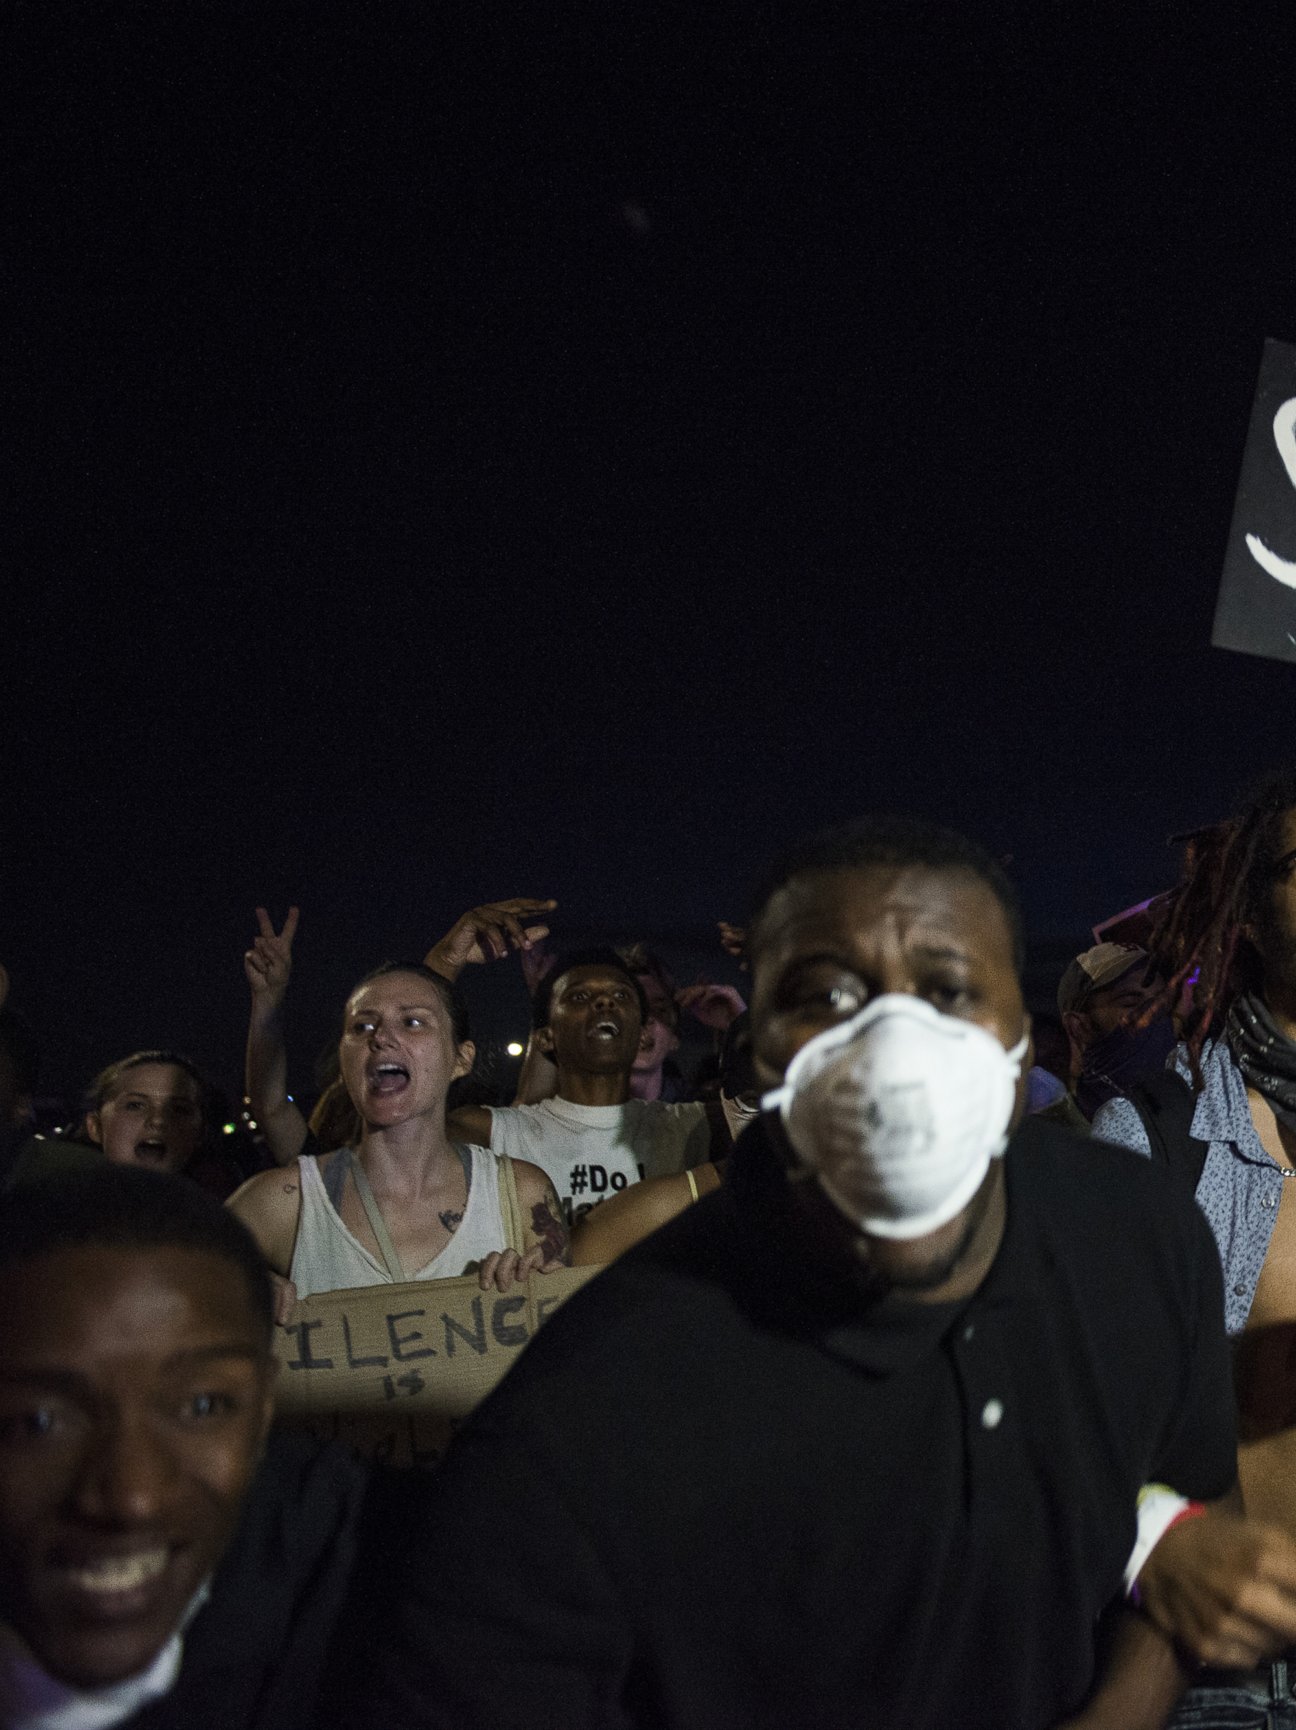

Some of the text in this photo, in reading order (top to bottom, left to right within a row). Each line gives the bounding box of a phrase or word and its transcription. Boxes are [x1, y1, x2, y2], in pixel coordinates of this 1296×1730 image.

[570, 1164, 627, 1195] #Do
[285, 1296, 561, 1370] ILENCE
[382, 1368, 426, 1401] IS
